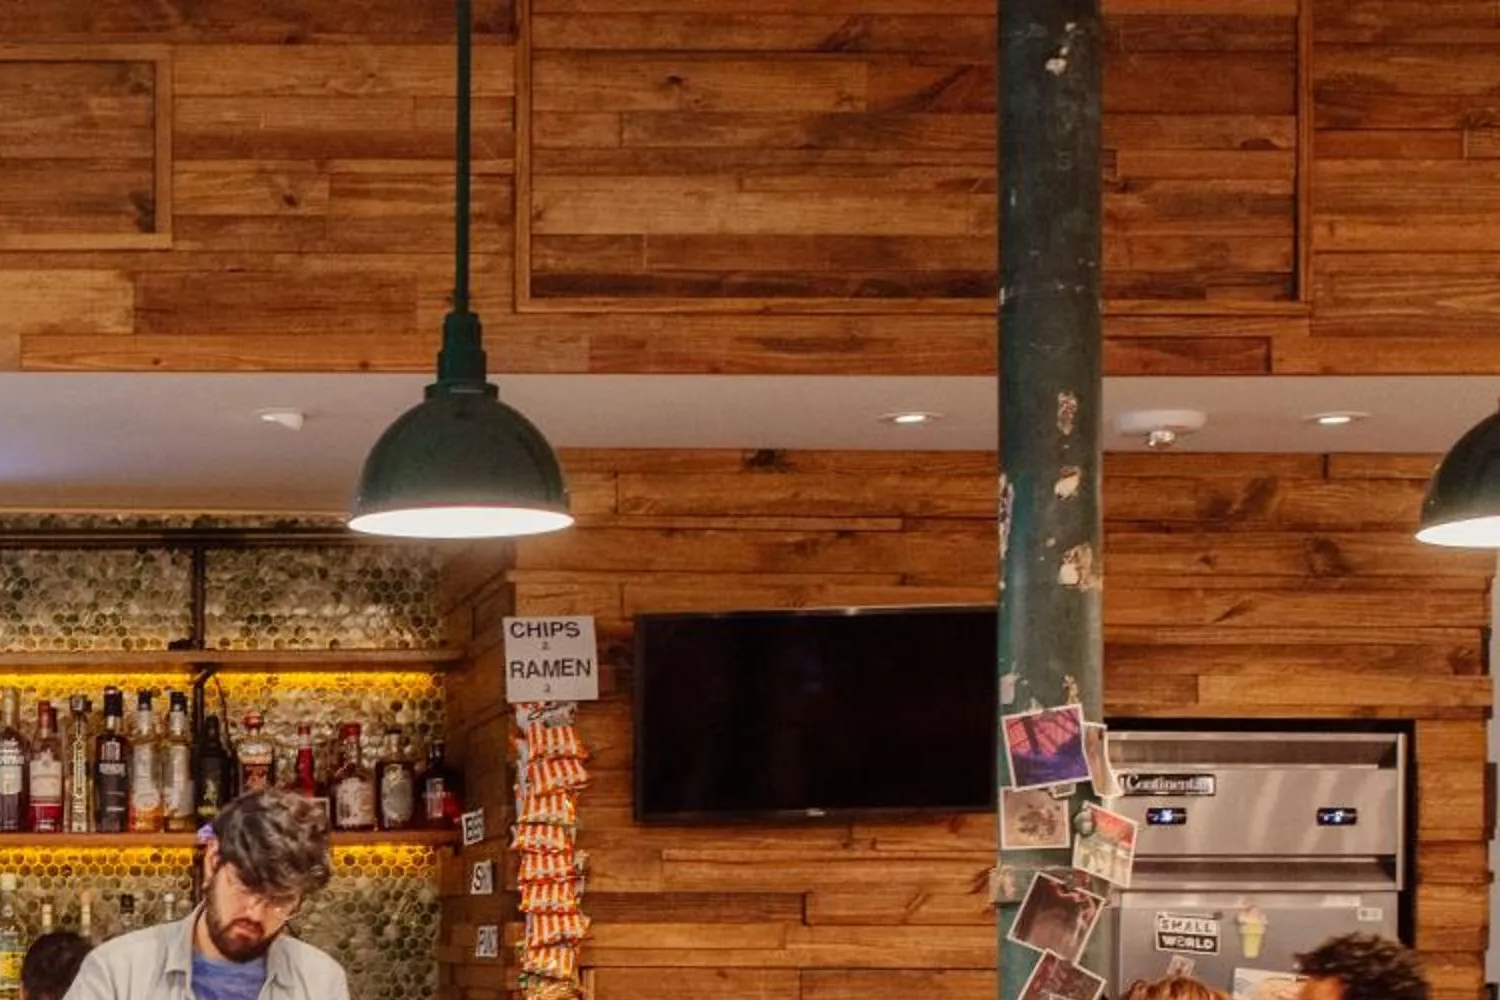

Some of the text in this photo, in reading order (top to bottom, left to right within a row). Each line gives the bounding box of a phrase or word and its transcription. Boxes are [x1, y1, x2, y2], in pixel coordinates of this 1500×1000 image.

[510, 621, 580, 638] CHIPS
[509, 658, 591, 679] RAMEN
[1161, 919, 1213, 933] SMALL
